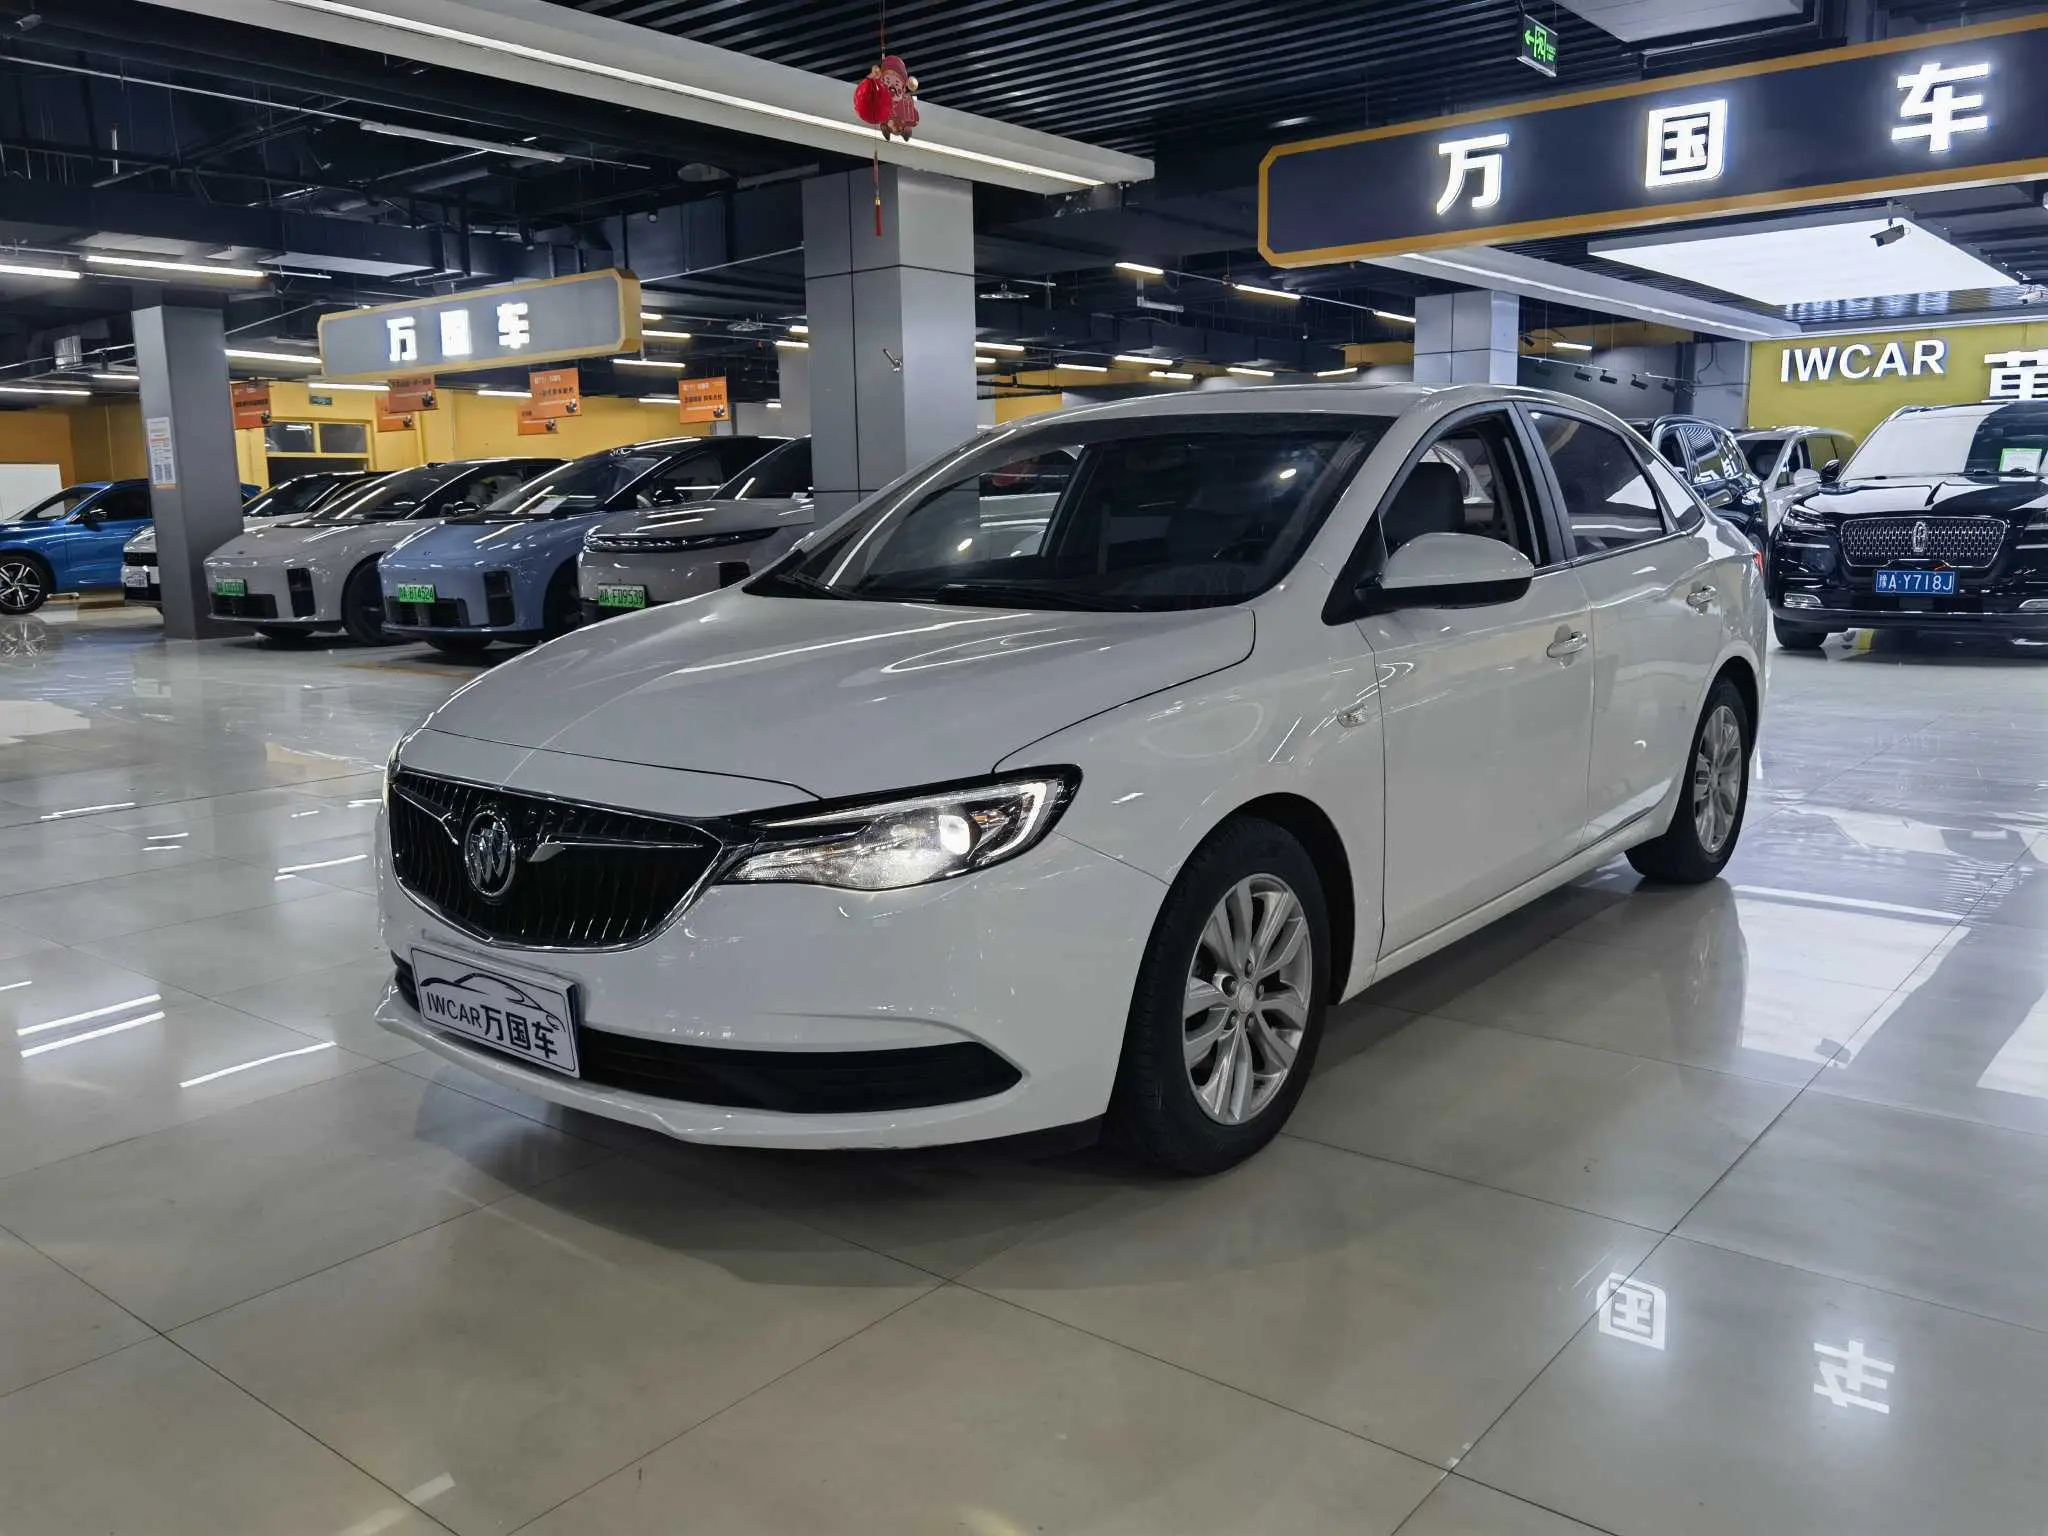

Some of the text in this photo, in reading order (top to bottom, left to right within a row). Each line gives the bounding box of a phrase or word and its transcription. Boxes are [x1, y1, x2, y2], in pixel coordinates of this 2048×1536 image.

[1436, 61, 1992, 216] 万国车
[1780, 338, 1947, 384] IWCAR
